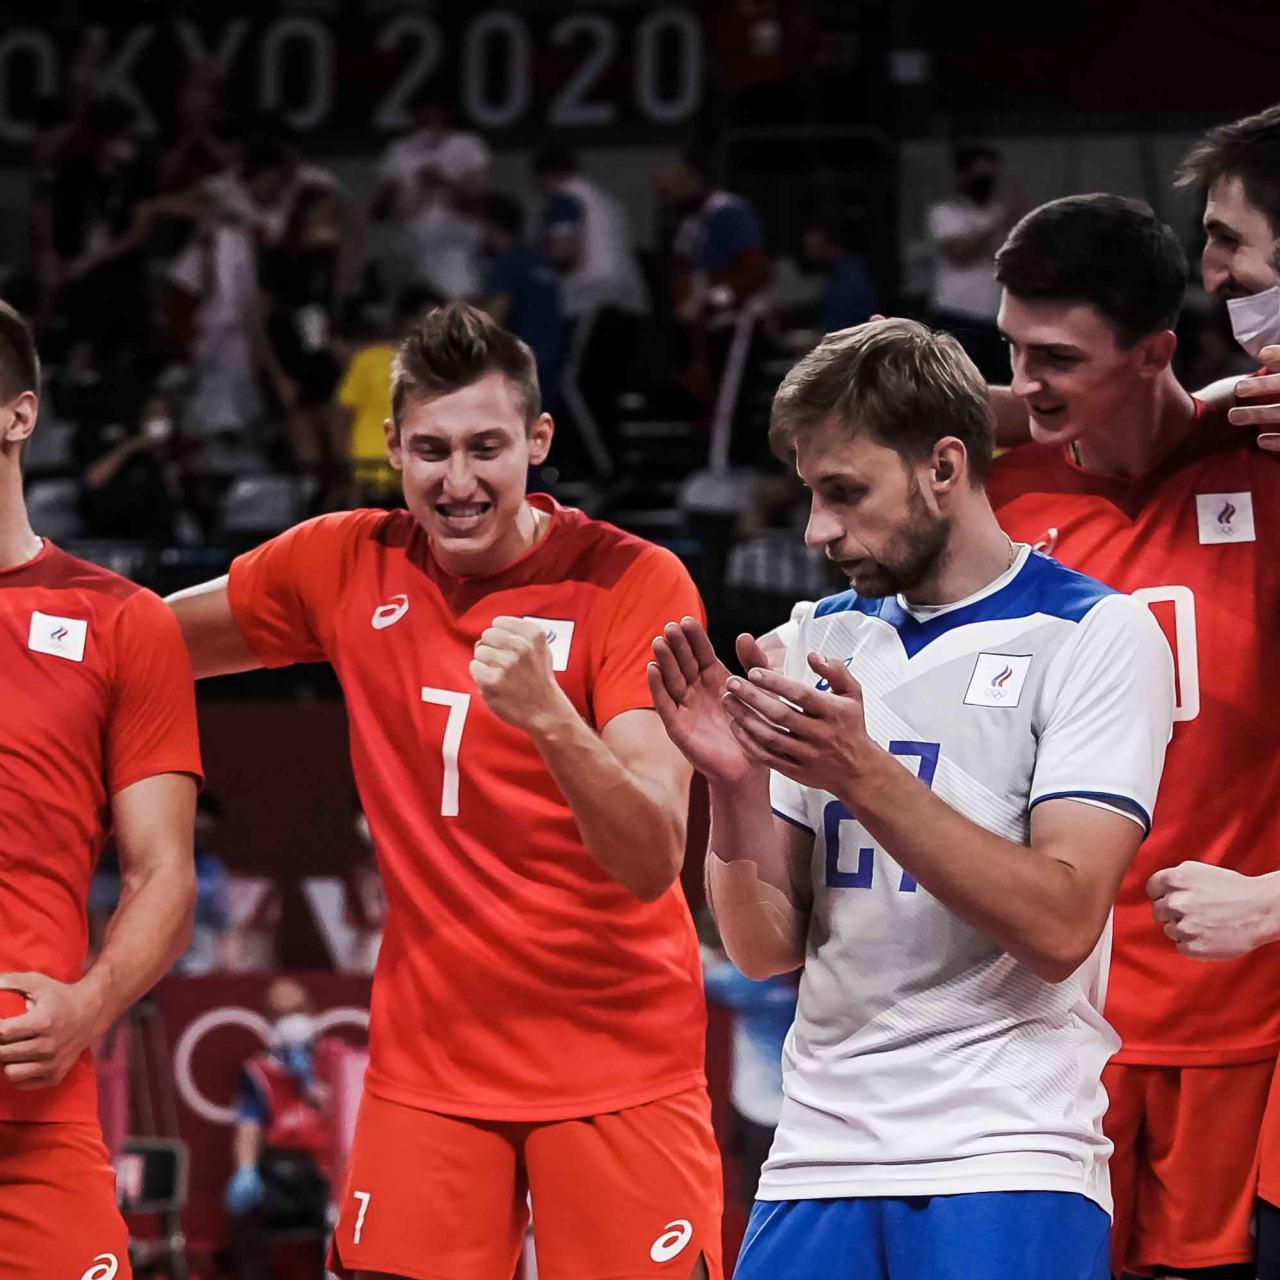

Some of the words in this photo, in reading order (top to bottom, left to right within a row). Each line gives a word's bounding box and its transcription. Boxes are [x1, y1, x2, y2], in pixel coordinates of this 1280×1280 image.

[373, 7, 707, 130] 2020
[421, 685, 471, 817] 7
[353, 1190, 371, 1244] 7
